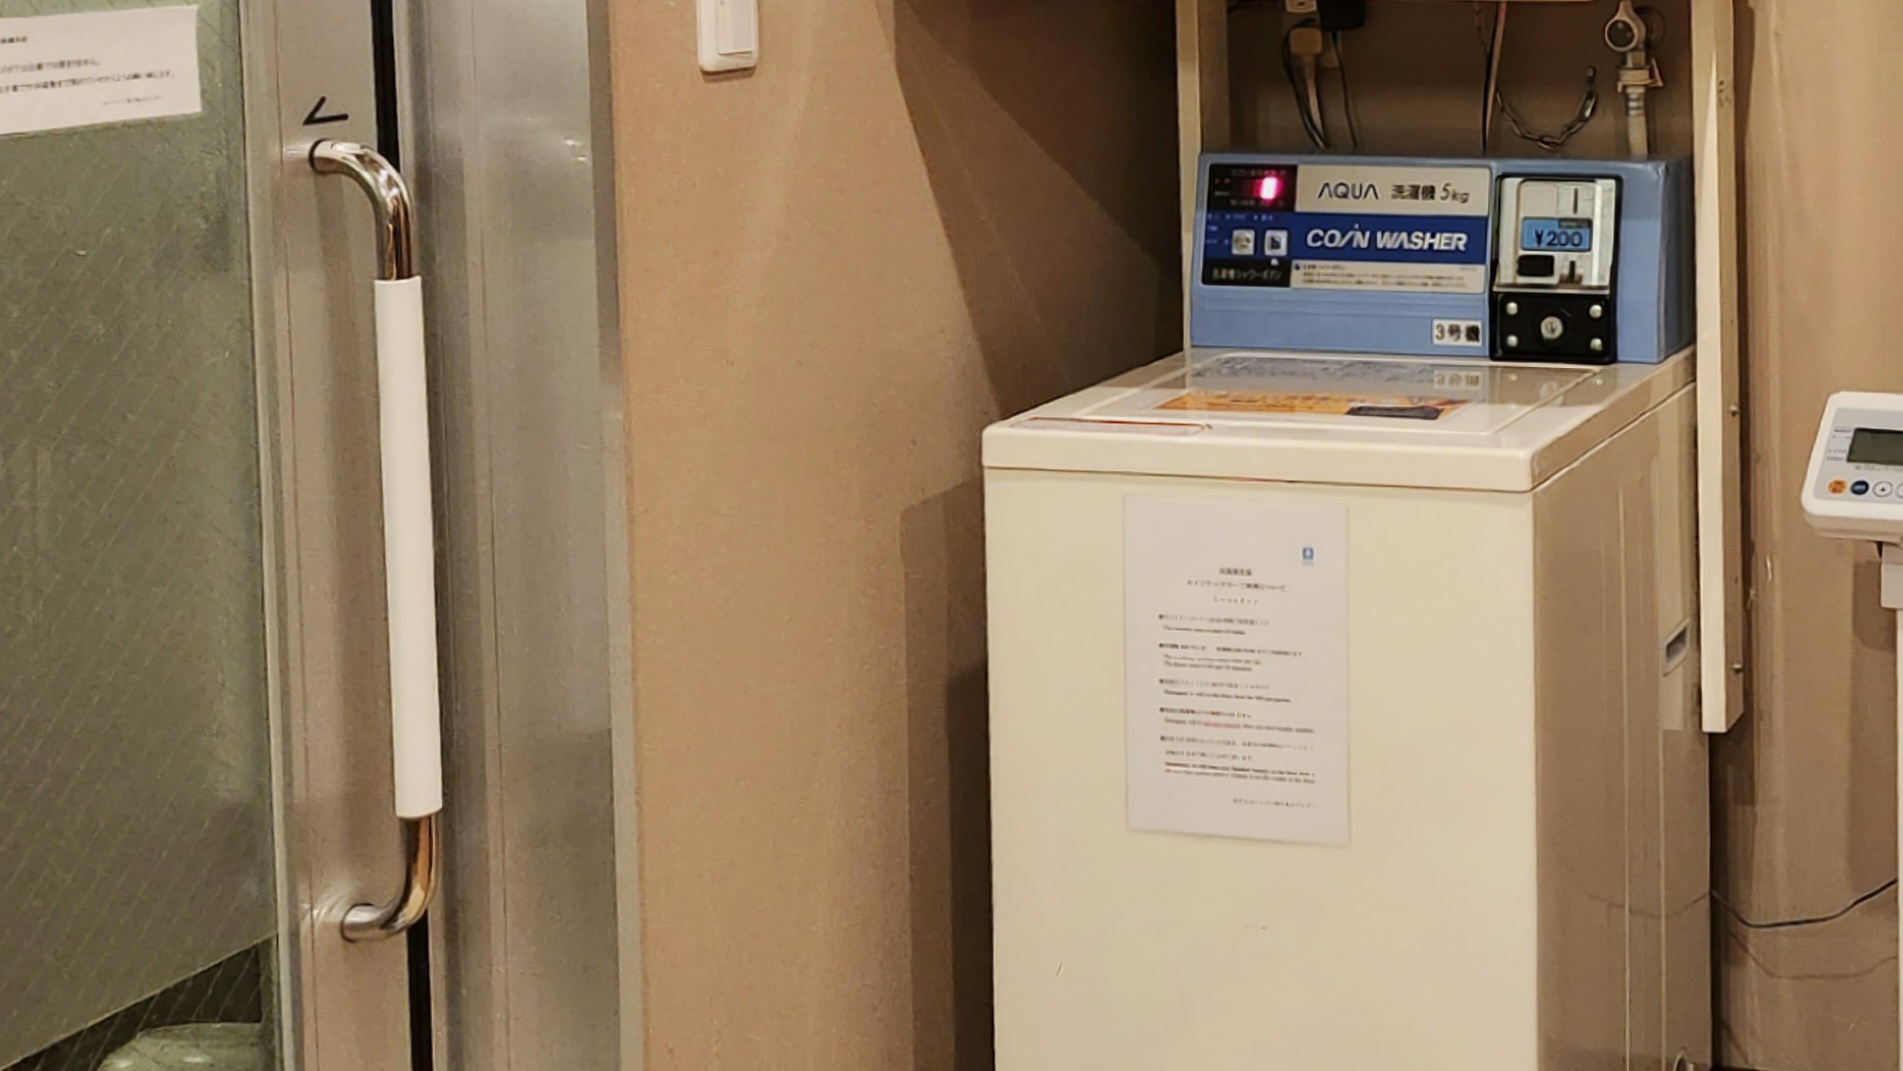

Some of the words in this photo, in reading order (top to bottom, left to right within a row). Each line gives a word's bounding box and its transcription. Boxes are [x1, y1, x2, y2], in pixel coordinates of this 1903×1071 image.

[1318, 181, 1379, 201] AQUA
[1390, 184, 1436, 201] 洗濯機
[1440, 182, 1470, 204] 5kg
[1307, 223, 1370, 249] COIN
[1376, 230, 1468, 251] WASHER
[1534, 229, 1584, 248] ¥200
[1435, 323, 1481, 343] 3号機
